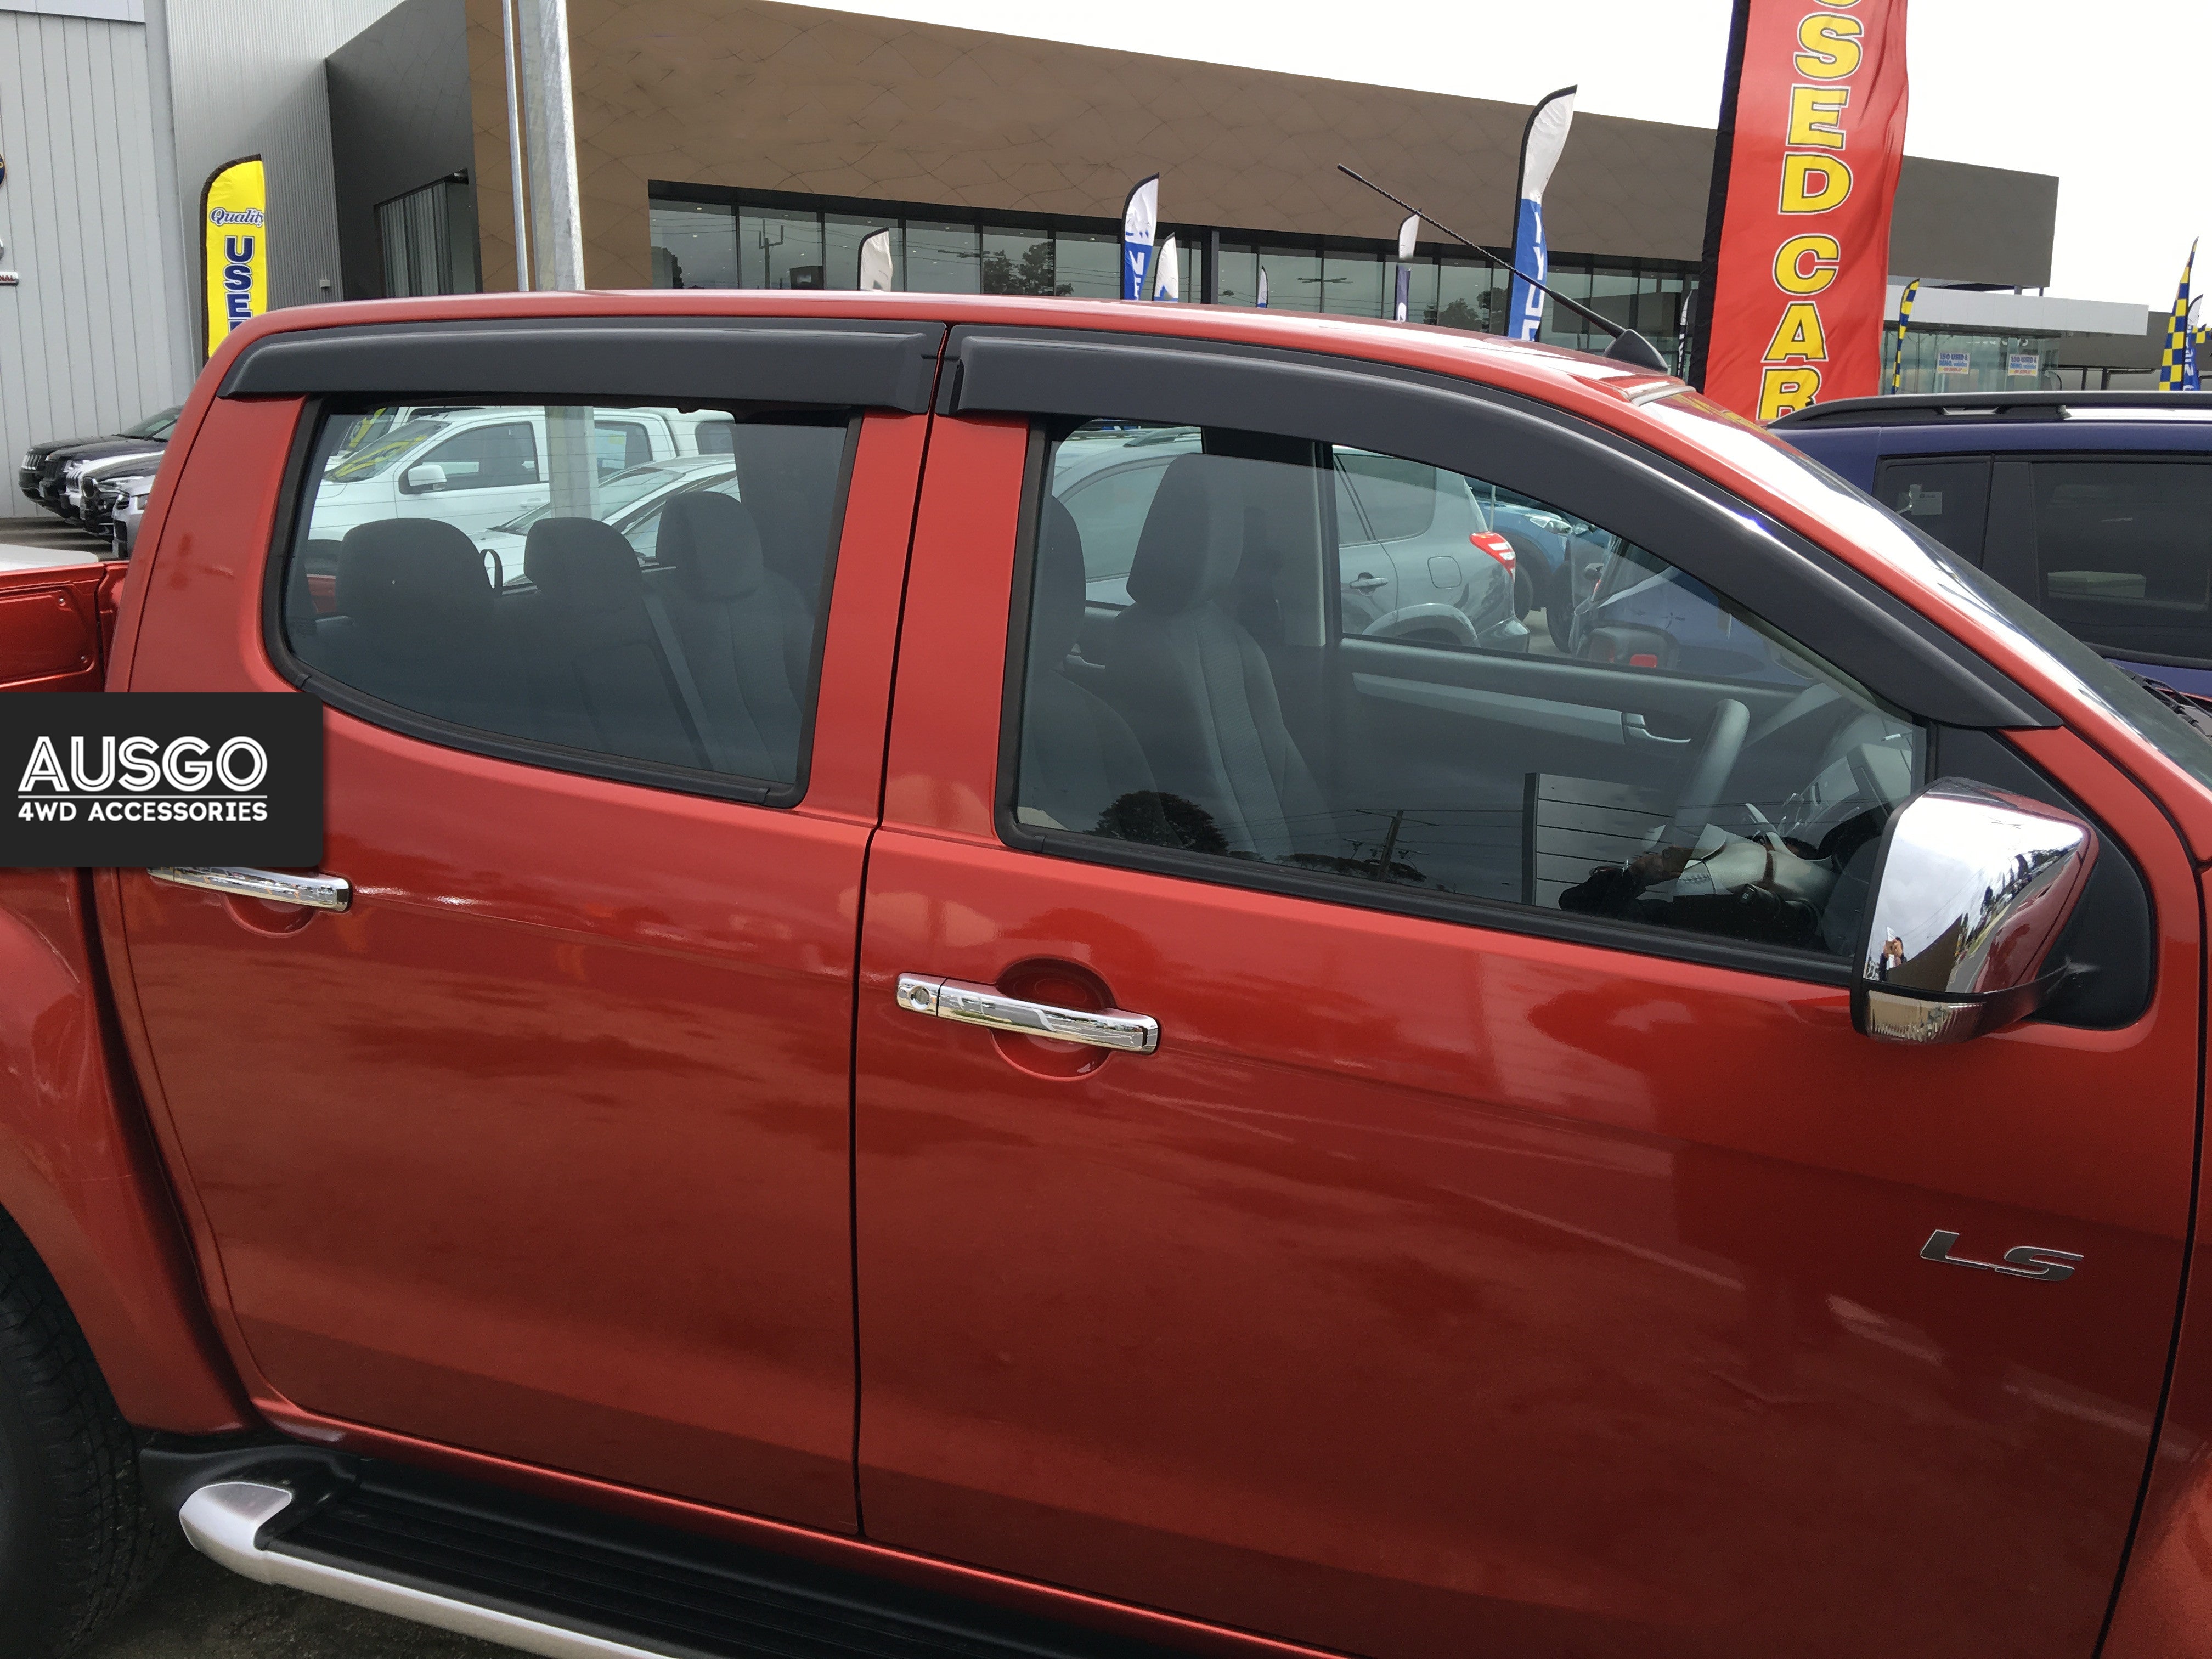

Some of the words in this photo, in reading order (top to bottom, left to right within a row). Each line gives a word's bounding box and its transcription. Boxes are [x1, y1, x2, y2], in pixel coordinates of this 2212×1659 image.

[1778, 0, 1864, 215] SED
[223, 236, 255, 332] USE
[1920, 1229, 2084, 1281] LS
